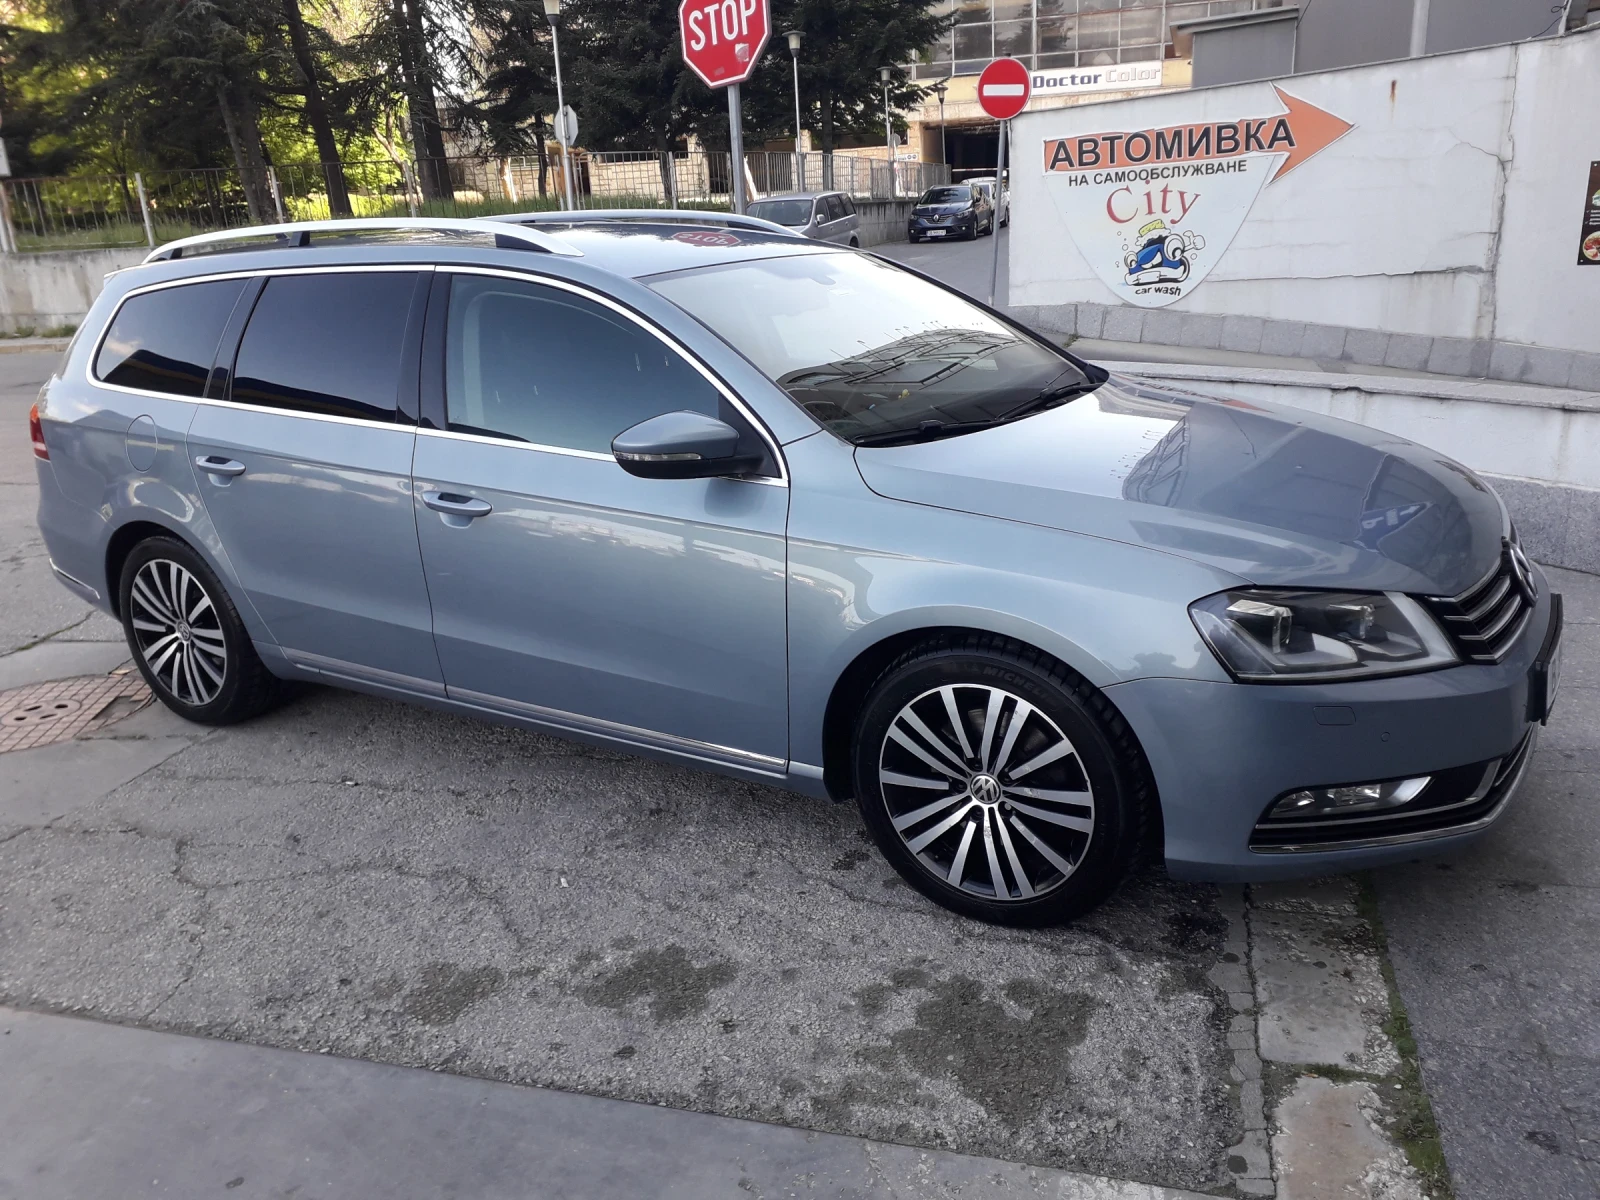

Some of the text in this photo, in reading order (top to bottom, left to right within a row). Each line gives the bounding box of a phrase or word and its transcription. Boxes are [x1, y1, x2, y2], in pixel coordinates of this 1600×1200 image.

[688, 0, 757, 51] STOP
[1032, 67, 1160, 88] Doctor Color
[1049, 118, 1296, 170] АВТОМИВКА
[1068, 160, 1247, 187] НА САМООБСЛУЖВАНЕ
[1106, 179, 1201, 224] City
[1135, 285, 1182, 296] car wash
